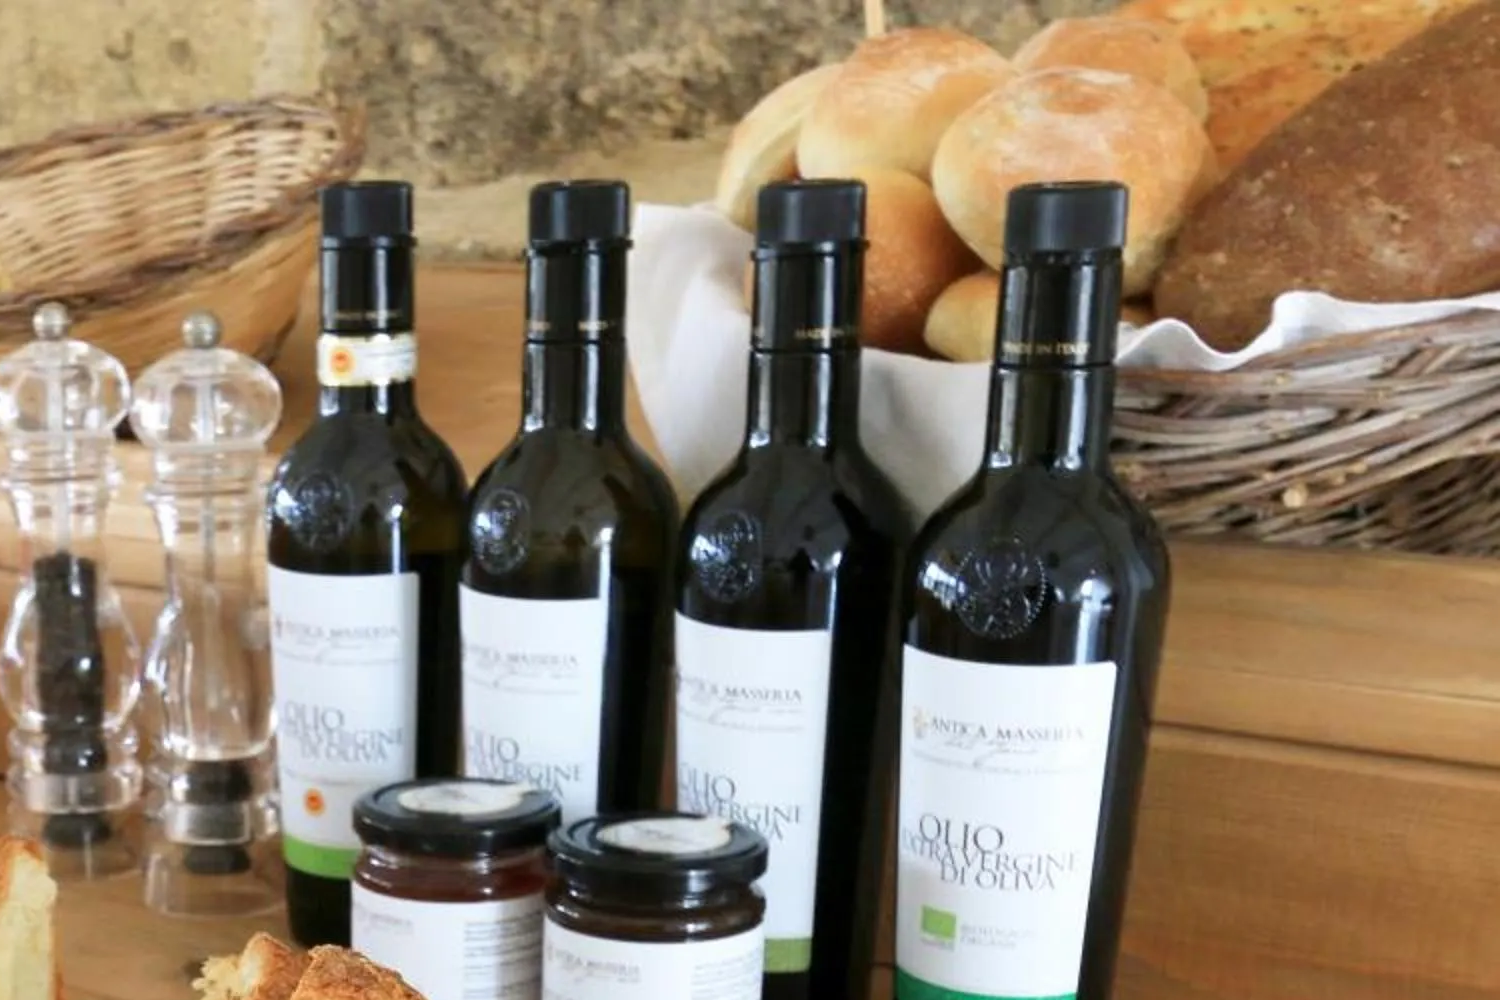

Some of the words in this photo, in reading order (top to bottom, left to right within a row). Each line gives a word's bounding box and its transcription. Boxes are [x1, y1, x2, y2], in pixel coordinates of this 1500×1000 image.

[284, 699, 346, 733] OLIO
[919, 812, 1004, 854] OLIO
[974, 866, 1056, 892] OLIVA
